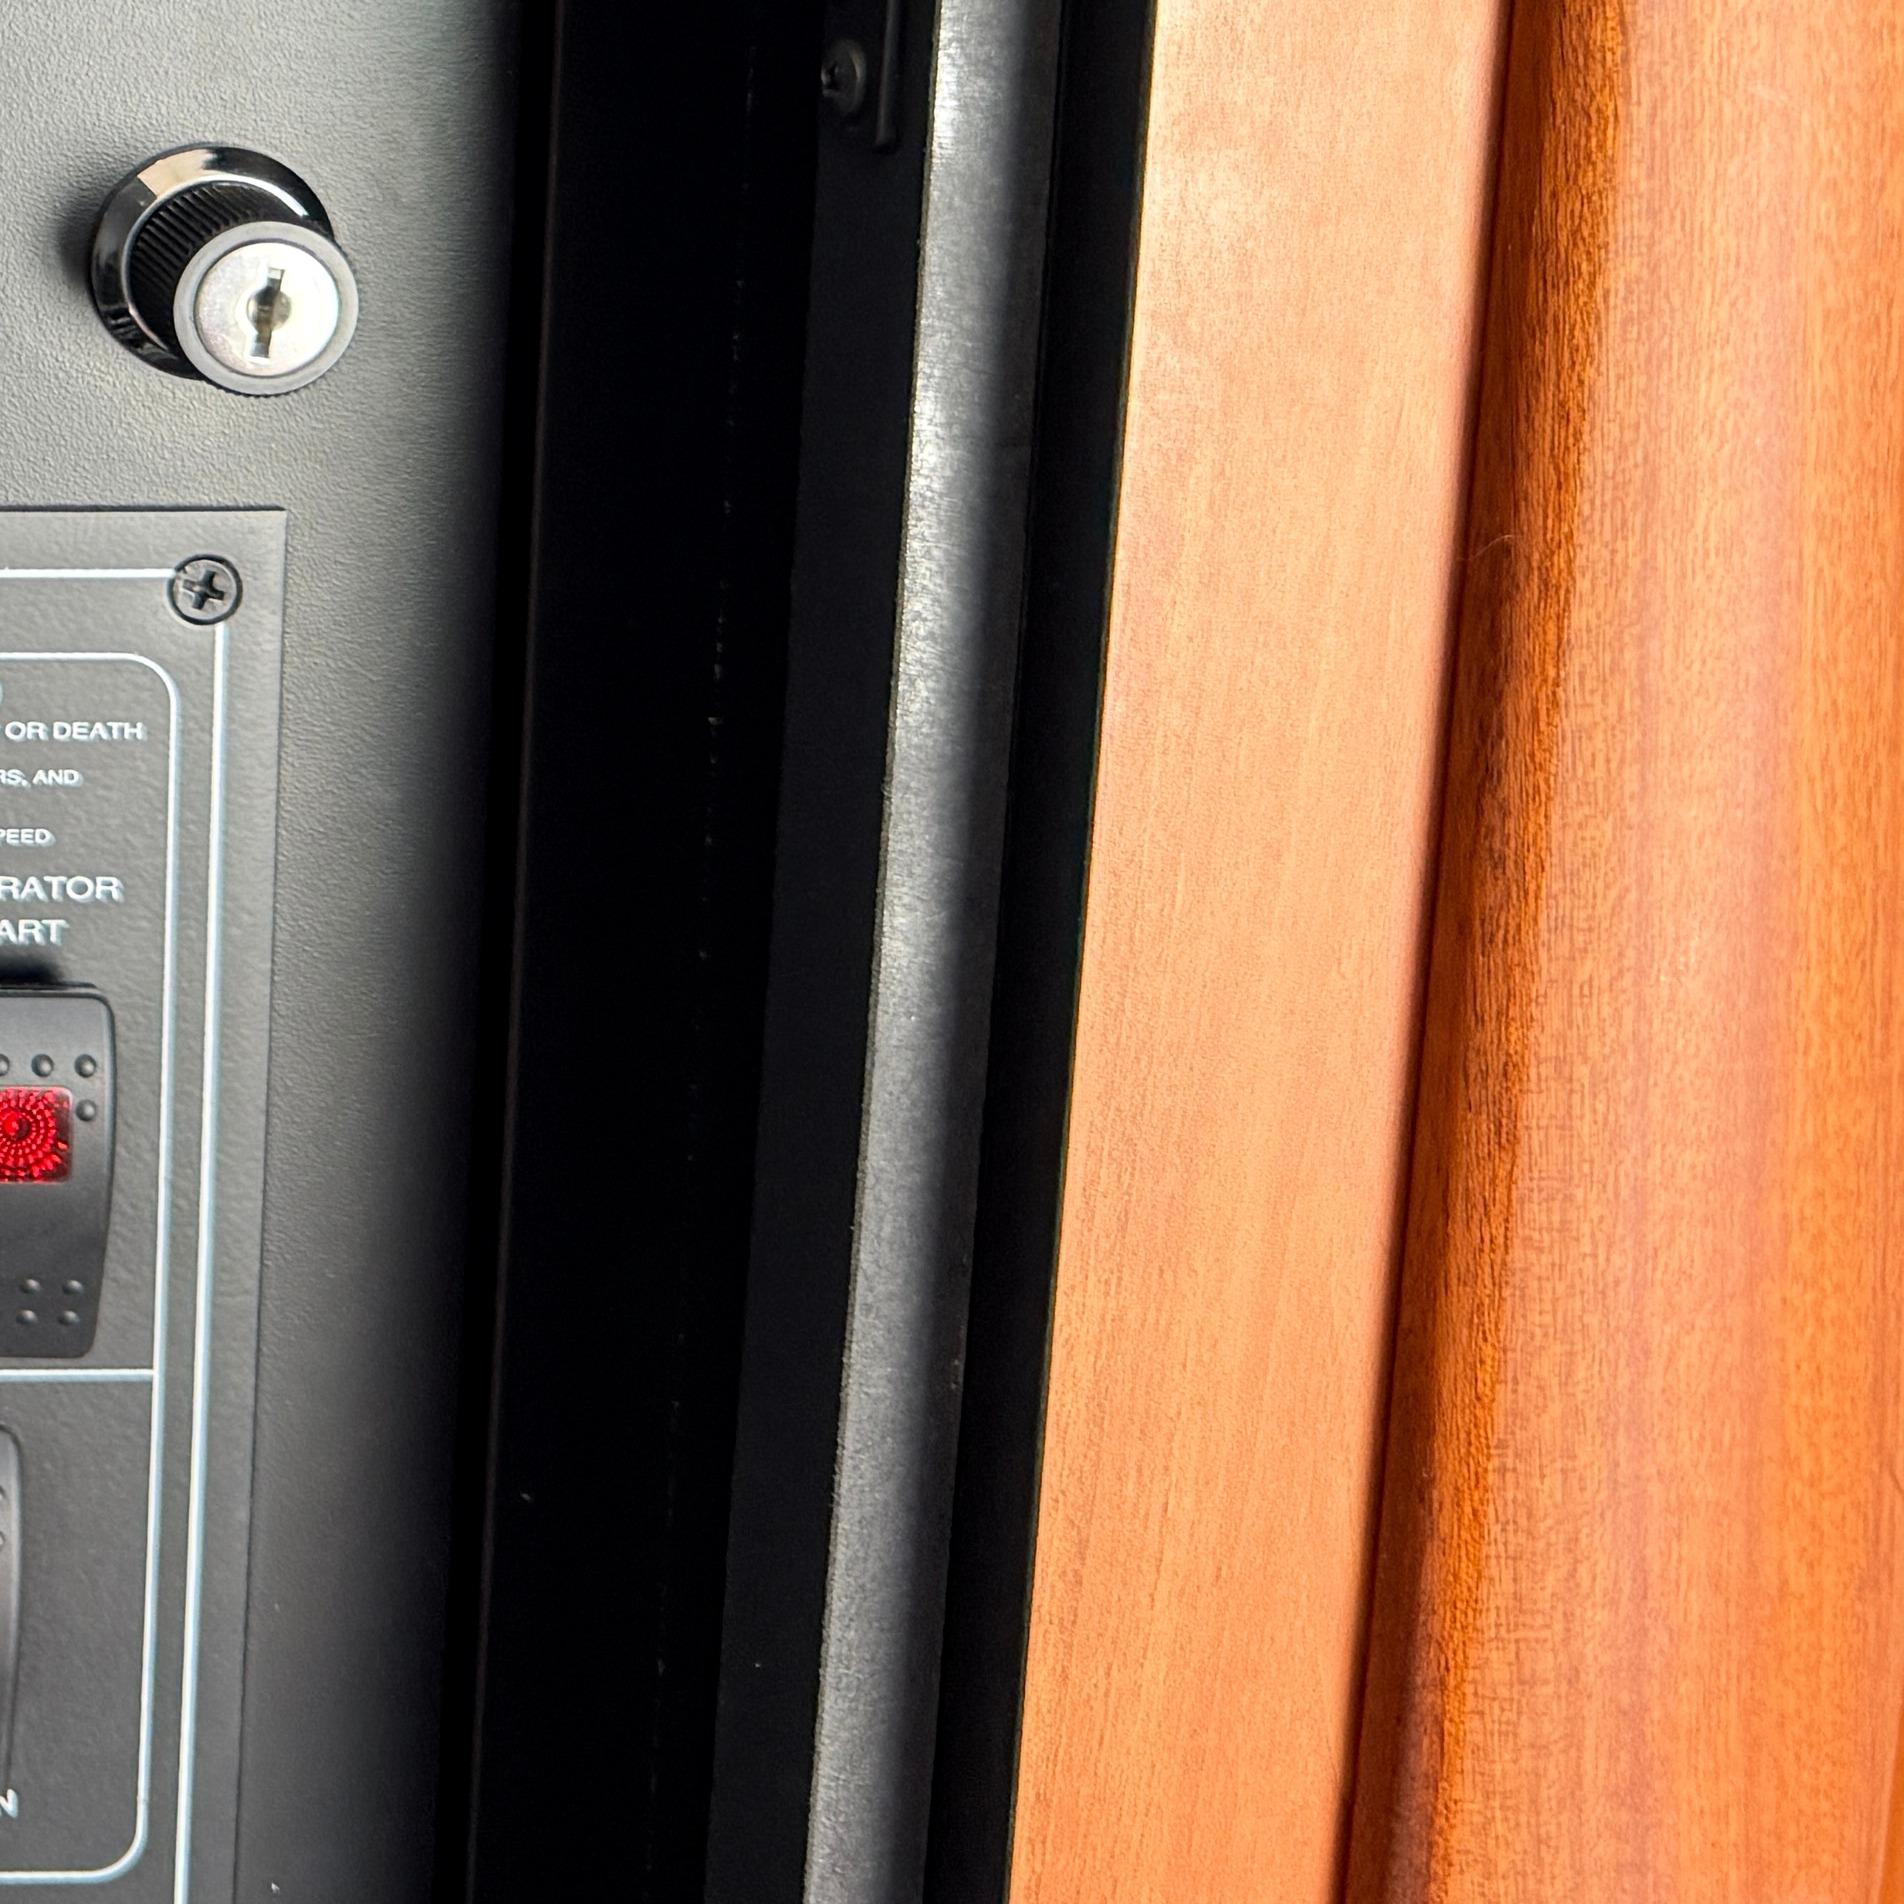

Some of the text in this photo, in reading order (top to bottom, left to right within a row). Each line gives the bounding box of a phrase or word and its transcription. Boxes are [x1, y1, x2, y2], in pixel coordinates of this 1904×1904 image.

[5, 721, 48, 741] OR
[53, 721, 145, 741] DEATH
[33, 769, 81, 785] AND
